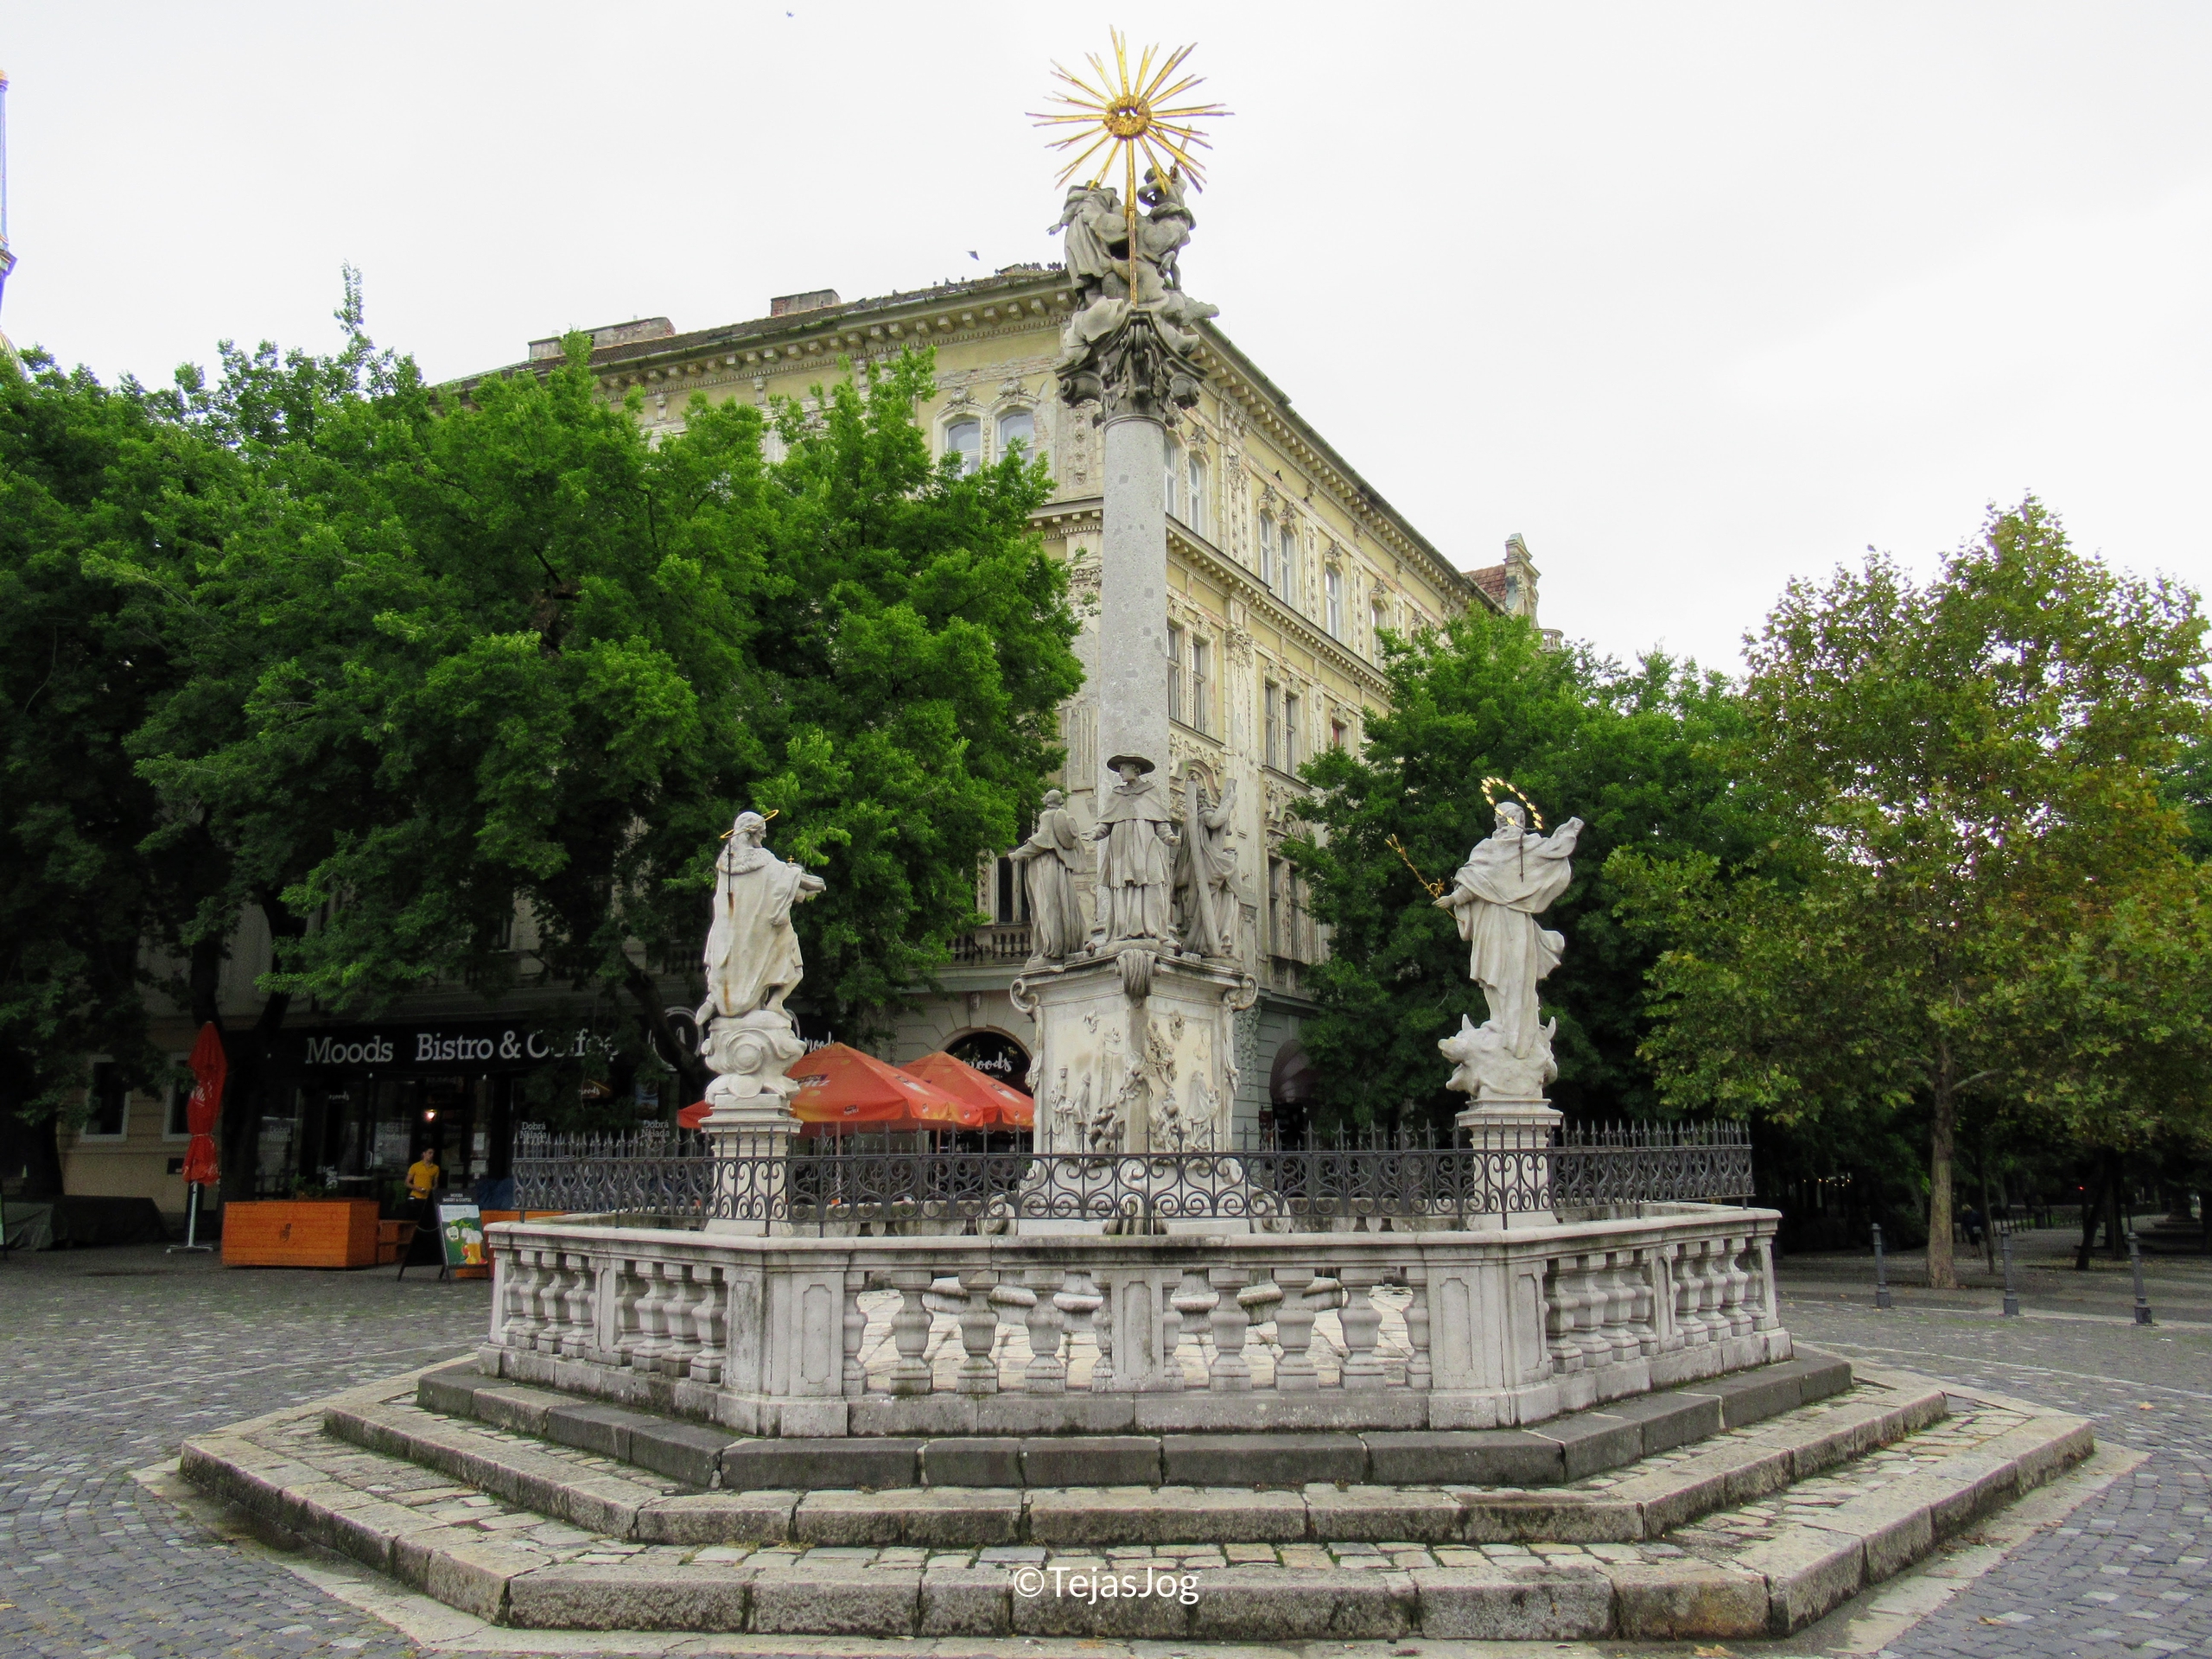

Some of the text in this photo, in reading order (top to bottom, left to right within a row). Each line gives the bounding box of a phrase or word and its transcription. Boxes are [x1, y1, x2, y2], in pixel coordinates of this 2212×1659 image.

[305, 1034, 394, 1065] Moods
[415, 1032, 494, 1062] Bistro
[499, 1029, 521, 1058] &
[804, 1030, 835, 1052] mood
[521, 1121, 546, 1130] Dobrá
